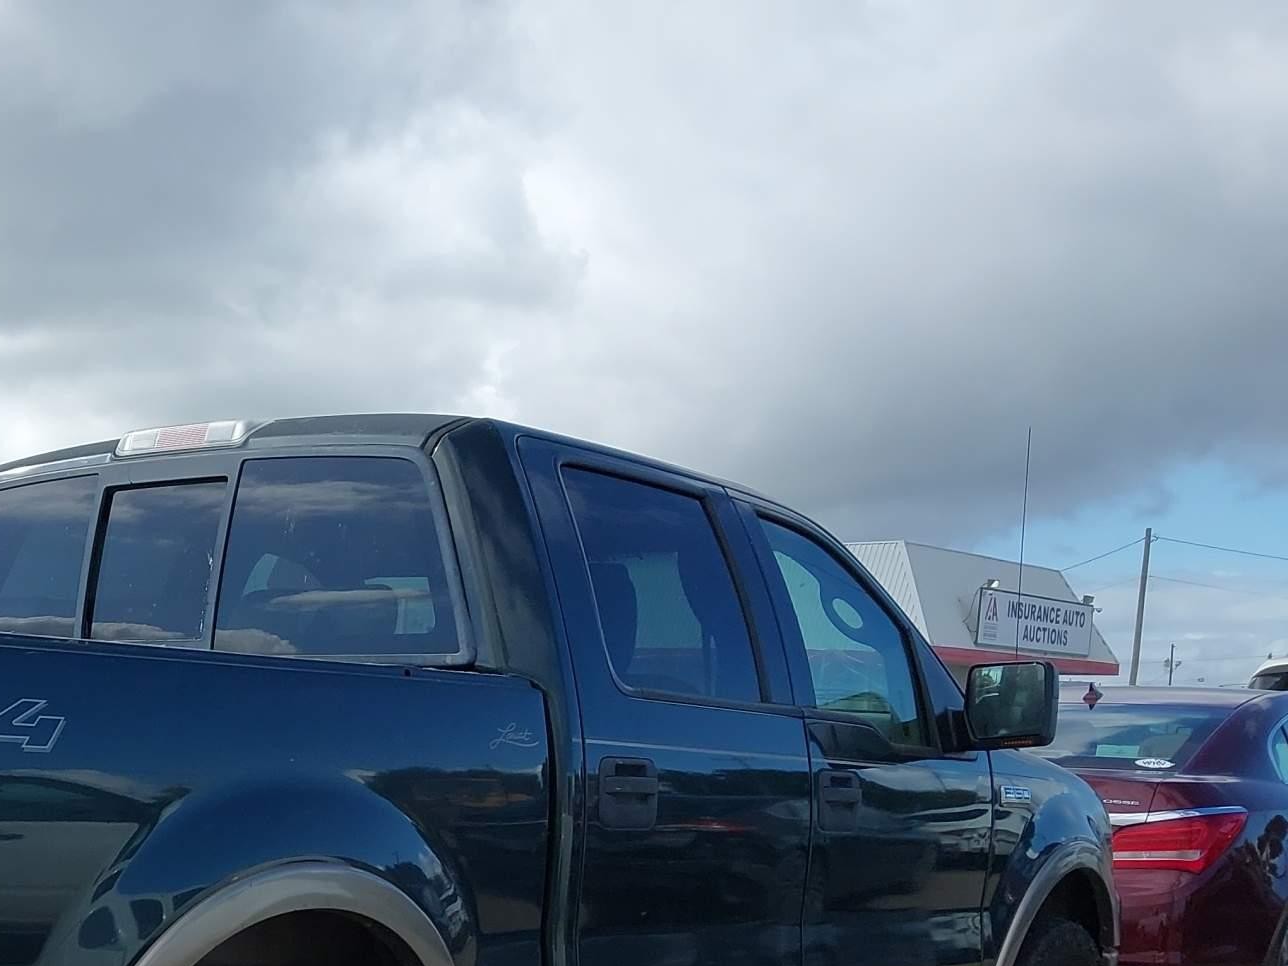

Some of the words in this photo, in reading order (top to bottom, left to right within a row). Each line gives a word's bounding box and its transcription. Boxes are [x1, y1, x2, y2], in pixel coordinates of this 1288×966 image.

[1007, 599, 1062, 625] INSURANCE
[1062, 609, 1086, 628] AUTO
[1022, 624, 1068, 646] AUCTIONS
